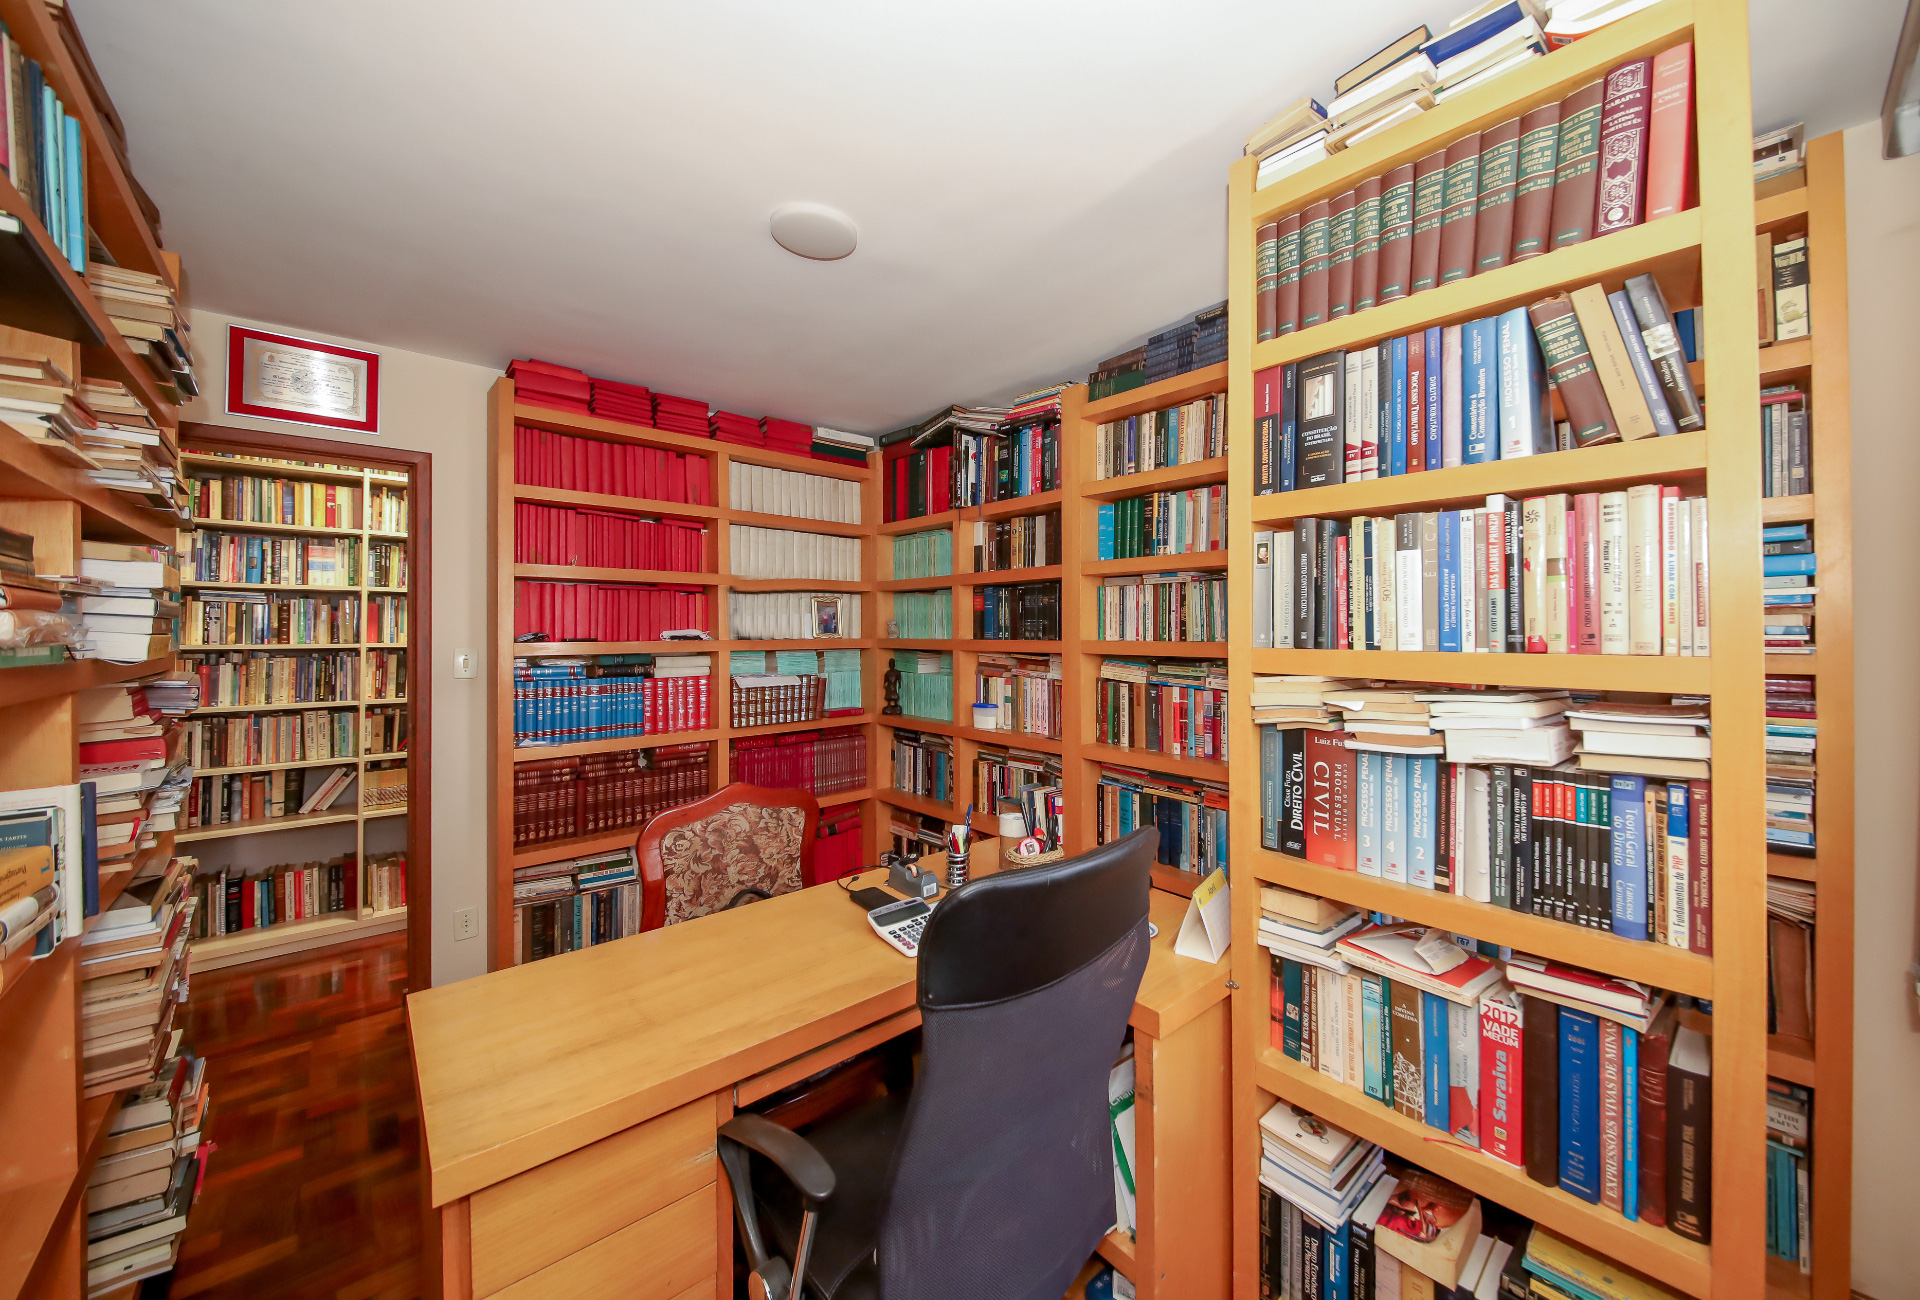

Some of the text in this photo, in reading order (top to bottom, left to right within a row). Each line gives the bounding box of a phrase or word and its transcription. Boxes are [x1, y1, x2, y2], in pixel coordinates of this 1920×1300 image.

[1605, 92, 1641, 110] SARAIVA
[1609, 114, 1635, 126] LATINO
[1502, 321, 1513, 408] PROCESSO PENAL
[1411, 371, 1419, 446] PROCESSO TRIBUTÁRIO
[1478, 368, 1488, 438] Constituição Brasileira
[1469, 400, 1477, 440] Comentários
[1509, 416, 1516, 429] 1
[1314, 432, 1331, 440] BRASIL
[1425, 517, 1437, 578] ÉTICA
[1489, 514, 1499, 589] DAS DILBERT PRINZIP
[1383, 590, 1391, 602] 50
[1315, 737, 1345, 747] Luiz Fu
[1414, 759, 1422, 788] PENAL
[1291, 752, 1303, 830] DIREITO CIVIL
[1313, 761, 1329, 836] CIVIL
[1334, 764, 1342, 840] PROCESSUAL
[1361, 780, 1369, 827] PROCESSO
[1699, 804, 1707, 826] TEMAS
[1363, 835, 1370, 847] 3
[1386, 840, 1395, 853] 4
[1614, 815, 1625, 866] do Direito
[1625, 809, 1638, 868] Teoria Geral
[1699, 828, 1708, 837] DE
[1416, 846, 1425, 860] 2
[1700, 838, 1708, 864] DIREITO
[1626, 882, 1636, 920] Francesco
[1672, 855, 1685, 927] Fundamentos de PHP
[1483, 1003, 1519, 1027] 2012
[1483, 1019, 1519, 1040] VADE
[1483, 1029, 1519, 1048] MECUM
[1492, 1050, 1506, 1122] Saraiva
[1604, 1020, 1618, 1198] EXPRESSÕES VIVAS DE MINAS
[1310, 1238, 1319, 1263] DIREITO
